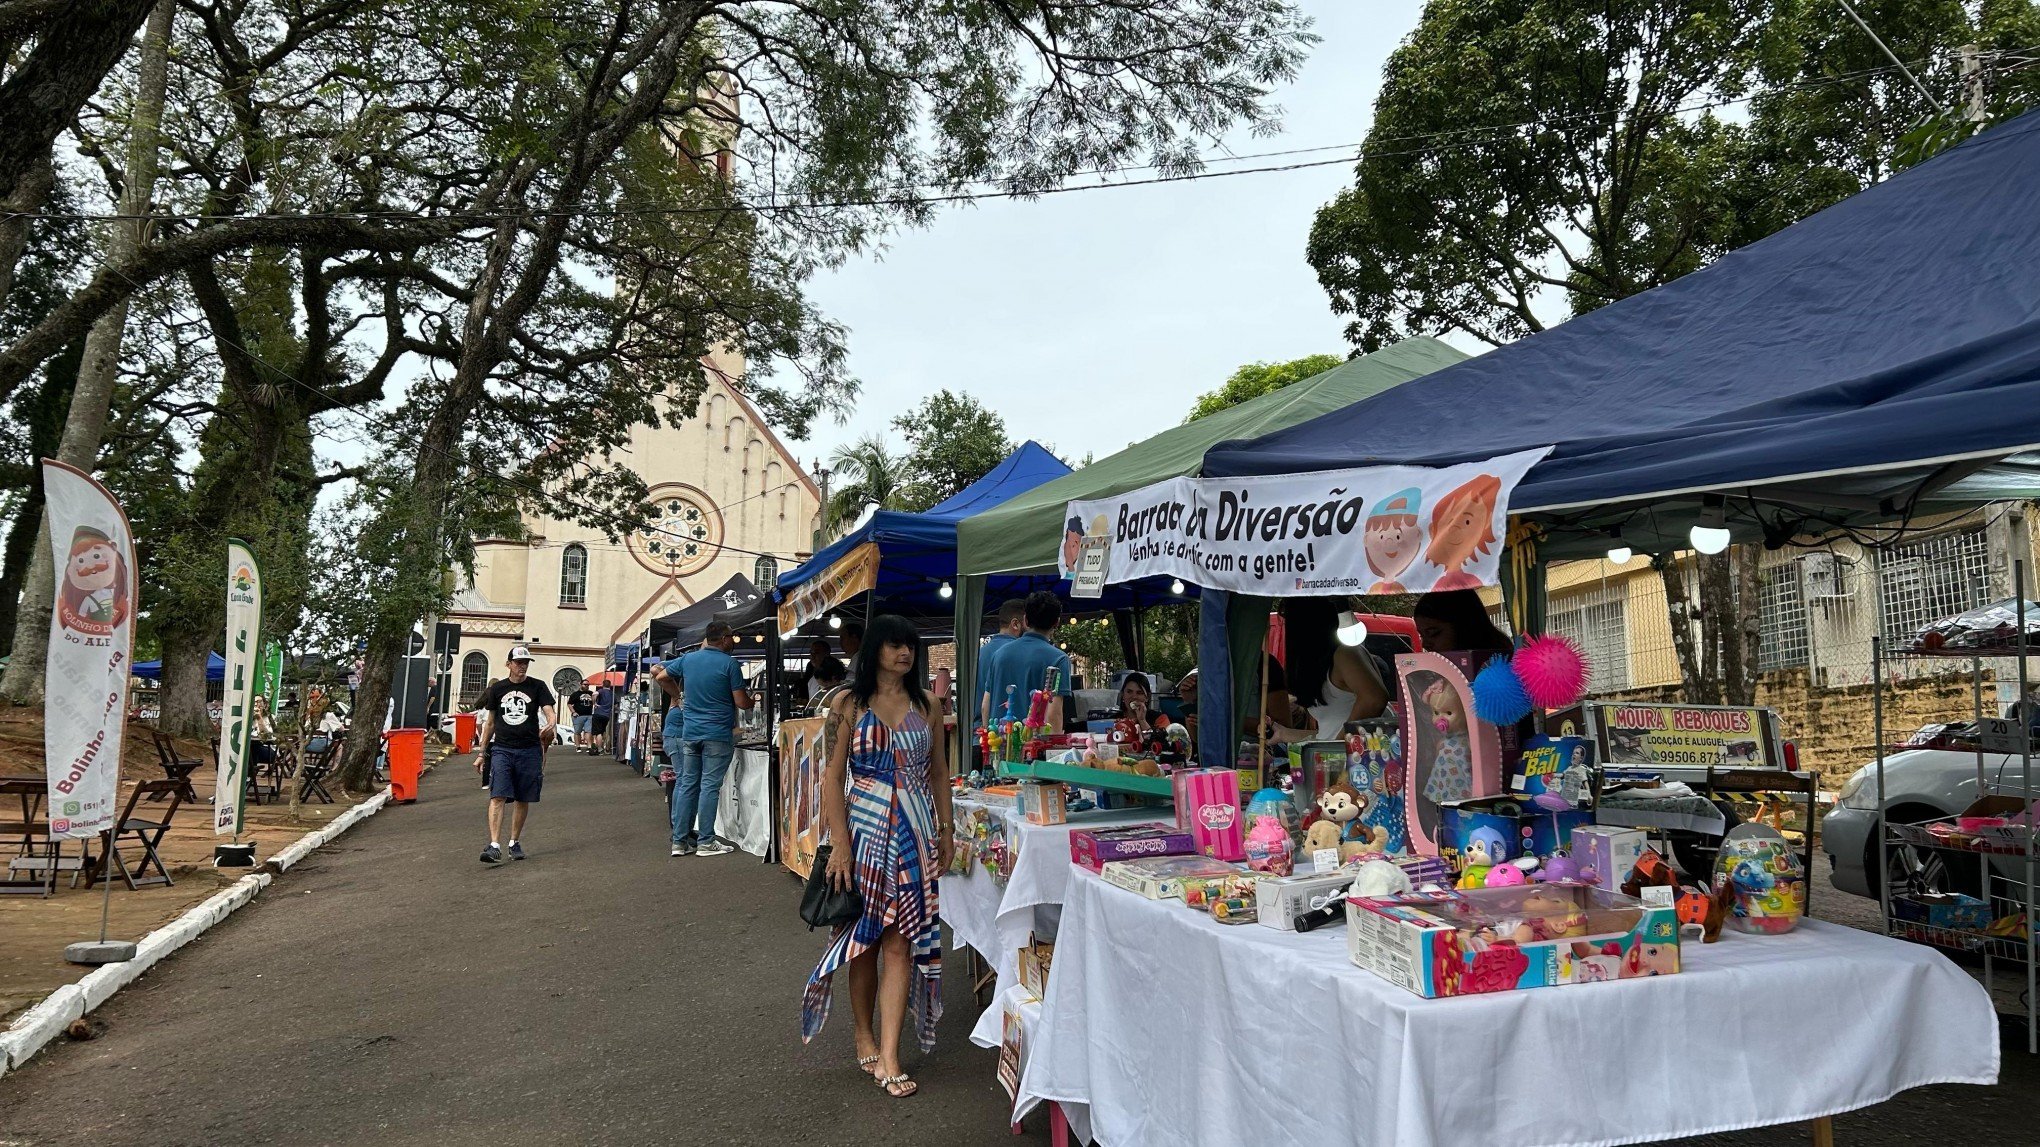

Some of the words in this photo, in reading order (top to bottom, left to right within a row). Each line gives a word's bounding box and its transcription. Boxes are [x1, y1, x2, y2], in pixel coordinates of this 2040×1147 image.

[1215, 488, 1364, 542] Diversão
[1086, 554, 1101, 566] TUDO
[1129, 537, 1160, 562] Venha
[1205, 552, 1234, 571] com
[1238, 554, 1248, 572] a
[1253, 543, 1316, 581] gente!
[64, 633, 80, 644] DO
[1614, 707, 1668, 730] MOURA
[1672, 709, 1751, 733] REBOQUES
[1990, 720, 2008, 735] 20
[1646, 734, 1683, 748] LOCAÇÃO
[1685, 737, 1691, 746] E
[1691, 738, 1726, 747] ALUGUEL
[1522, 746, 1557, 760] Puffer
[1660, 750, 1728, 764] 99506.8731
[55, 729, 105, 795] Bolinho
[1524, 753, 1561, 777] Ball
[1352, 771, 1369, 785] 48
